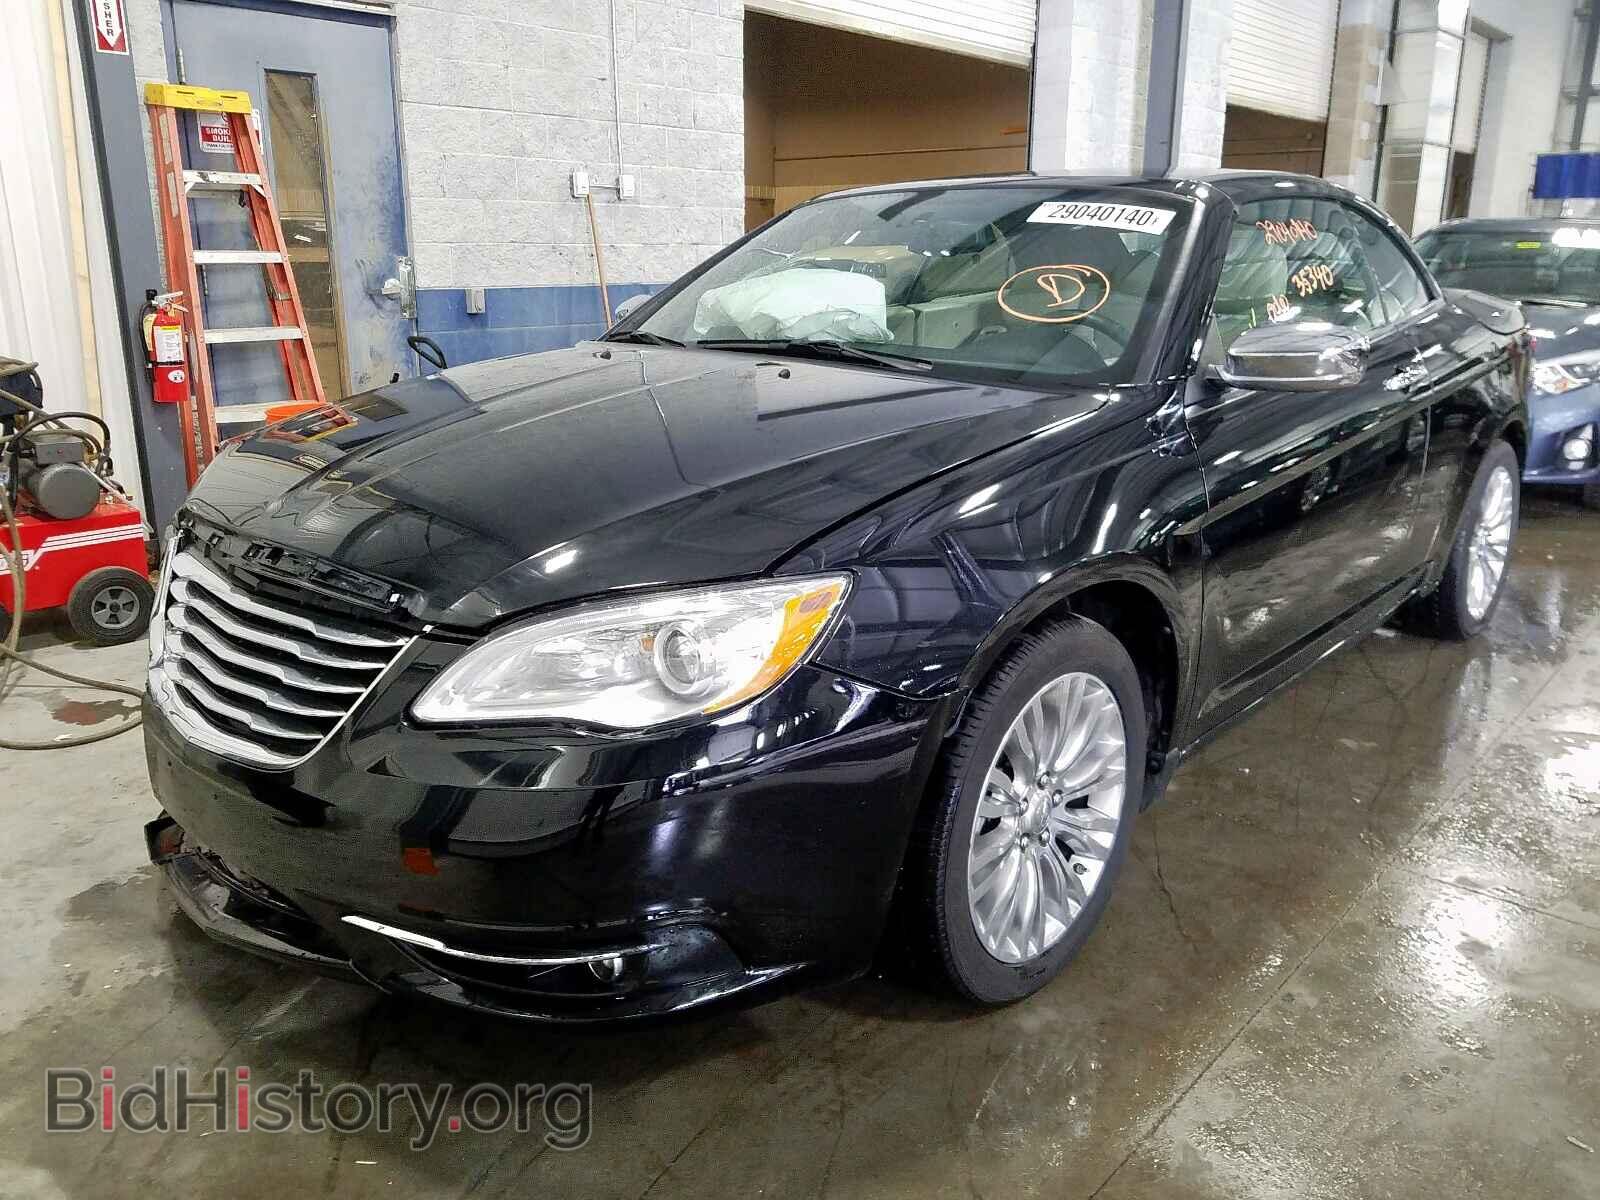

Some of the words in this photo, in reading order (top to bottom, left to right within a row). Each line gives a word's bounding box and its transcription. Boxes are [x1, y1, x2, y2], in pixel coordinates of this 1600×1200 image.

[103, 0, 114, 37] SHER
[212, 134, 233, 143] BUIL
[1047, 204, 1154, 226] 29040140
